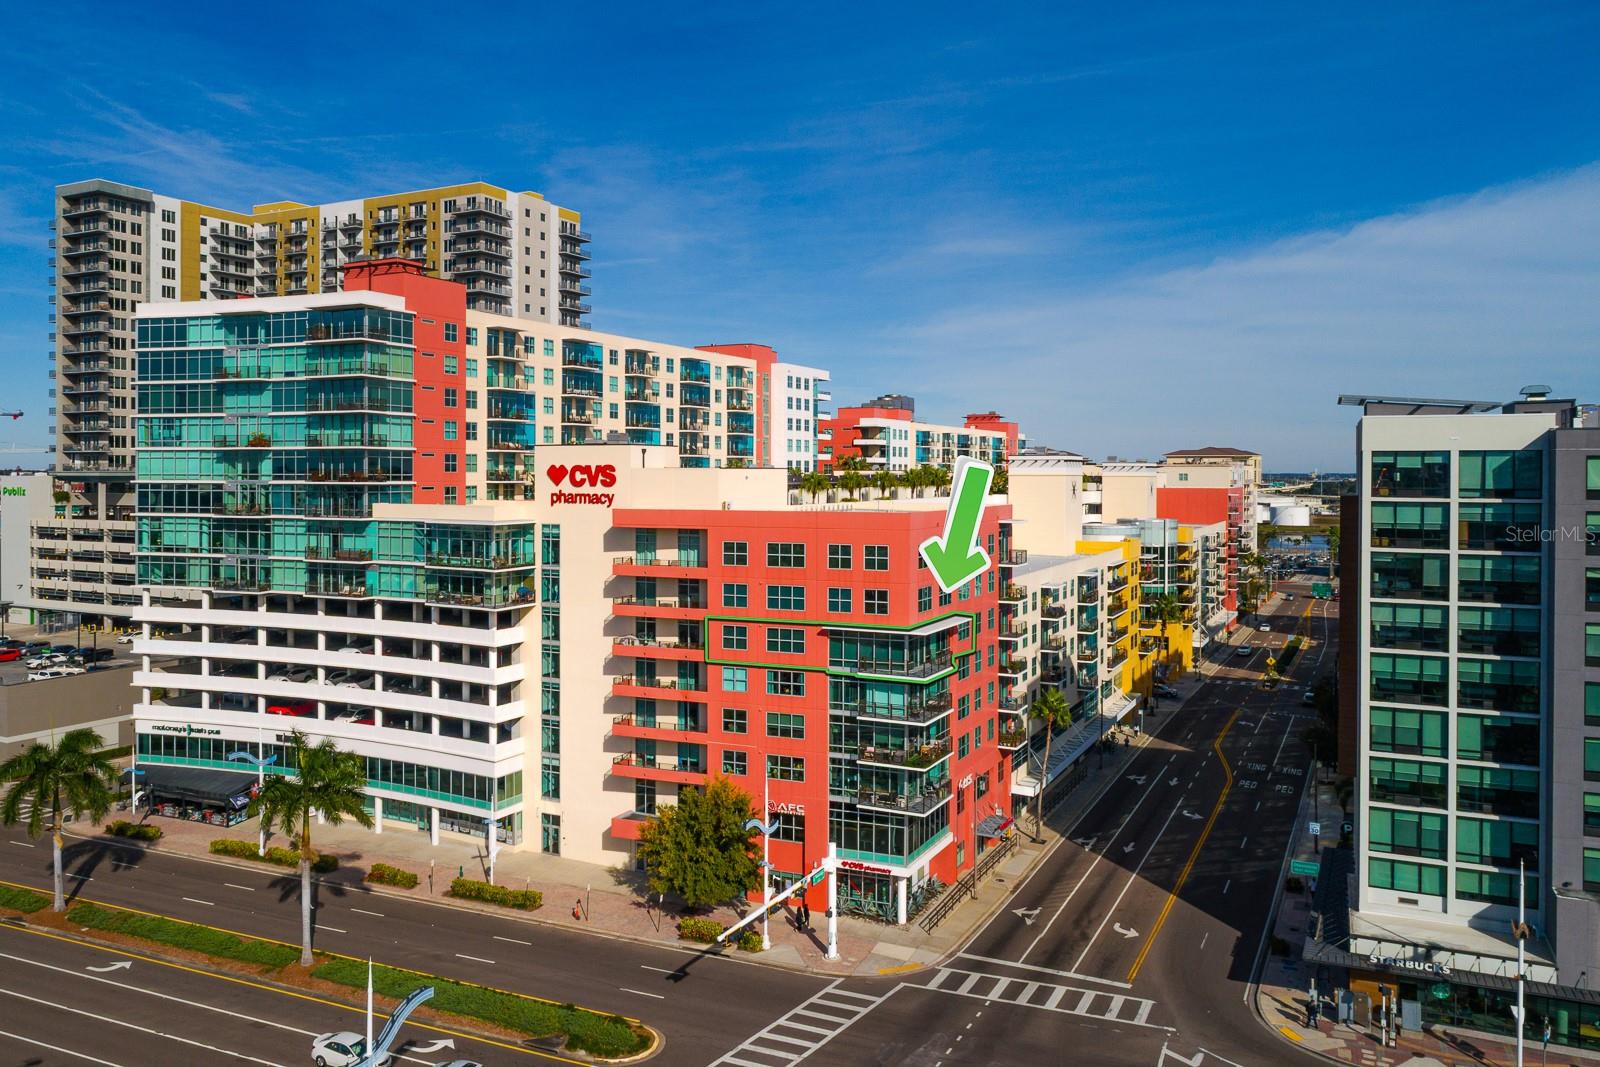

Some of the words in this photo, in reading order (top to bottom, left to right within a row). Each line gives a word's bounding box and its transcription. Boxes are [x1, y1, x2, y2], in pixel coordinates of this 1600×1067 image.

[569, 464, 617, 488] CVS
[550, 490, 615, 508] pharmacy
[777, 802, 805, 813] AFC
[1369, 954, 1451, 975] STARBUCKS
